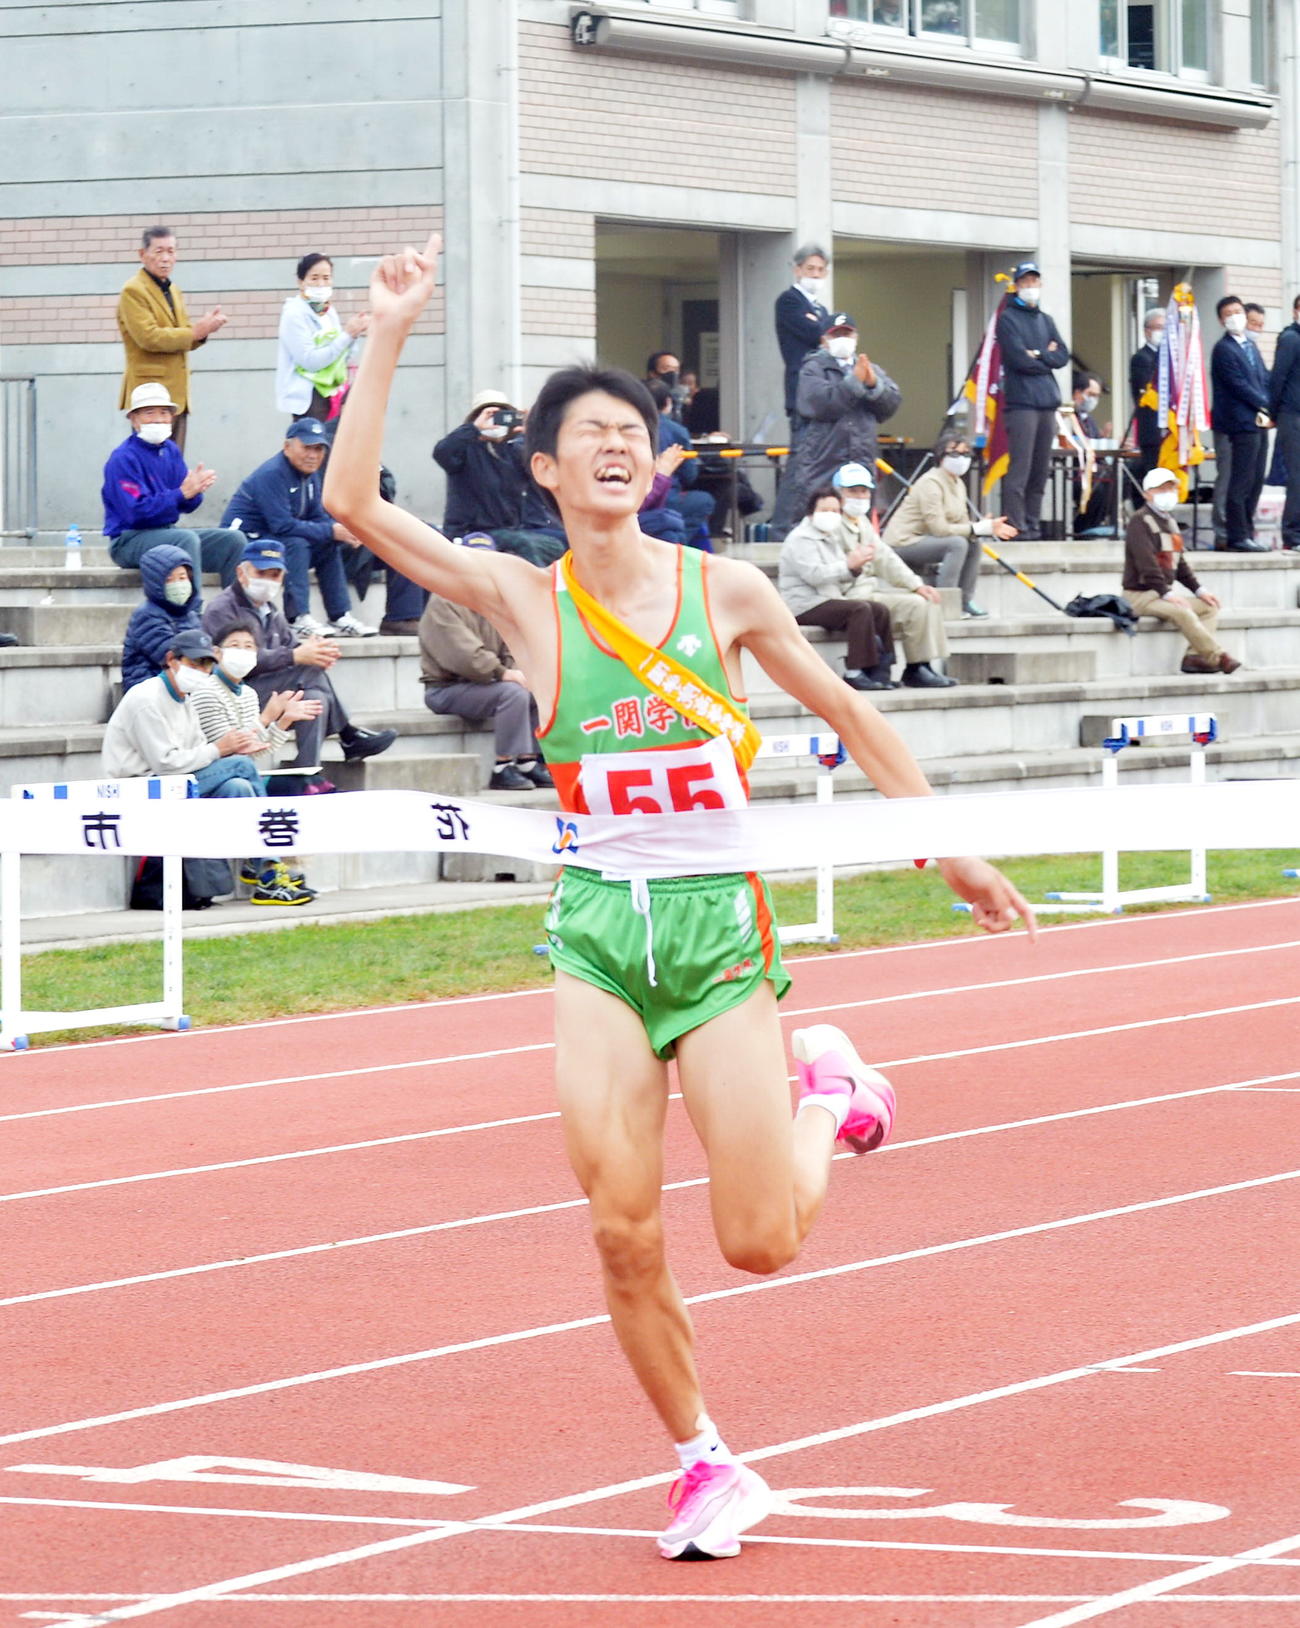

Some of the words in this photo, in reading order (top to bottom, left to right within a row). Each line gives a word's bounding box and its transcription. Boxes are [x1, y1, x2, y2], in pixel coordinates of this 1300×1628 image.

[580, 694, 699, 738] 一関学
[606, 762, 726, 815] 55
